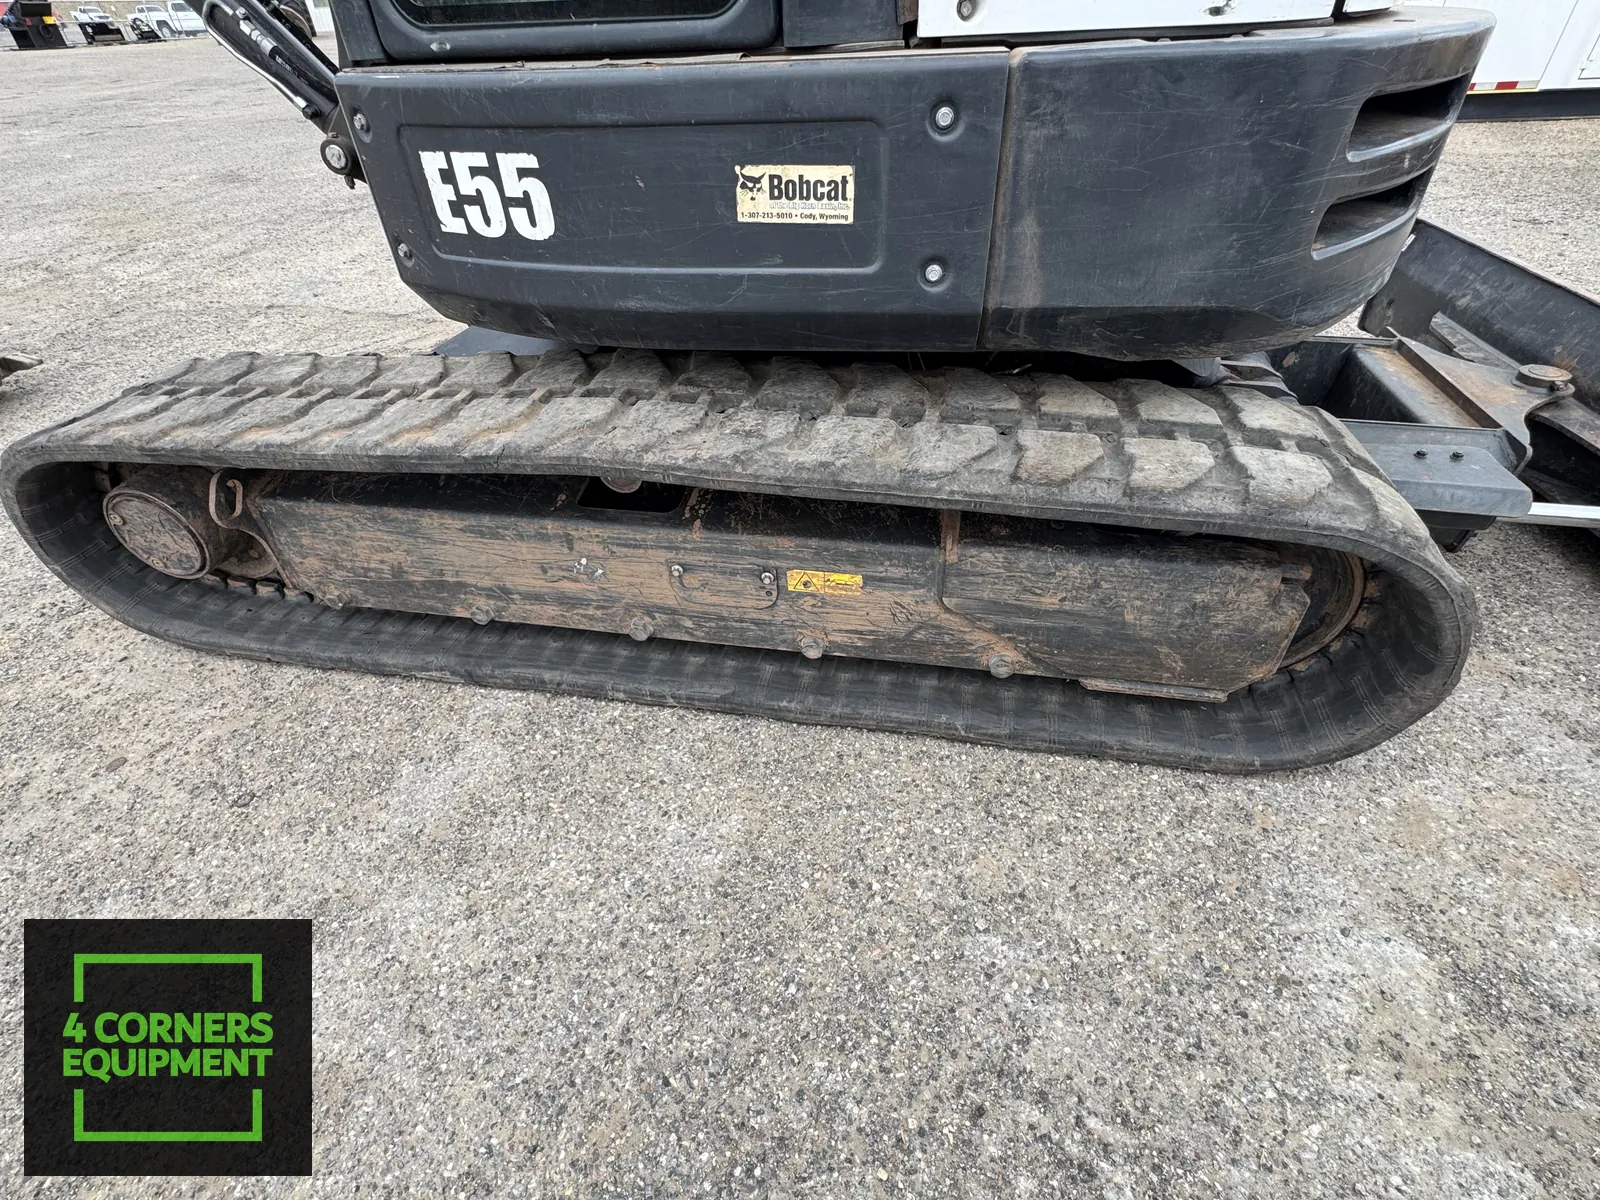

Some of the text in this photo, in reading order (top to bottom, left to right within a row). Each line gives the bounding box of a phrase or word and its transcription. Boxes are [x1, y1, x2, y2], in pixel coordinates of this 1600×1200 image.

[418, 151, 555, 241] E55
[768, 174, 849, 201] Bobcat
[800, 212, 818, 221] Cody,
[819, 213, 849, 221] Wyoming
